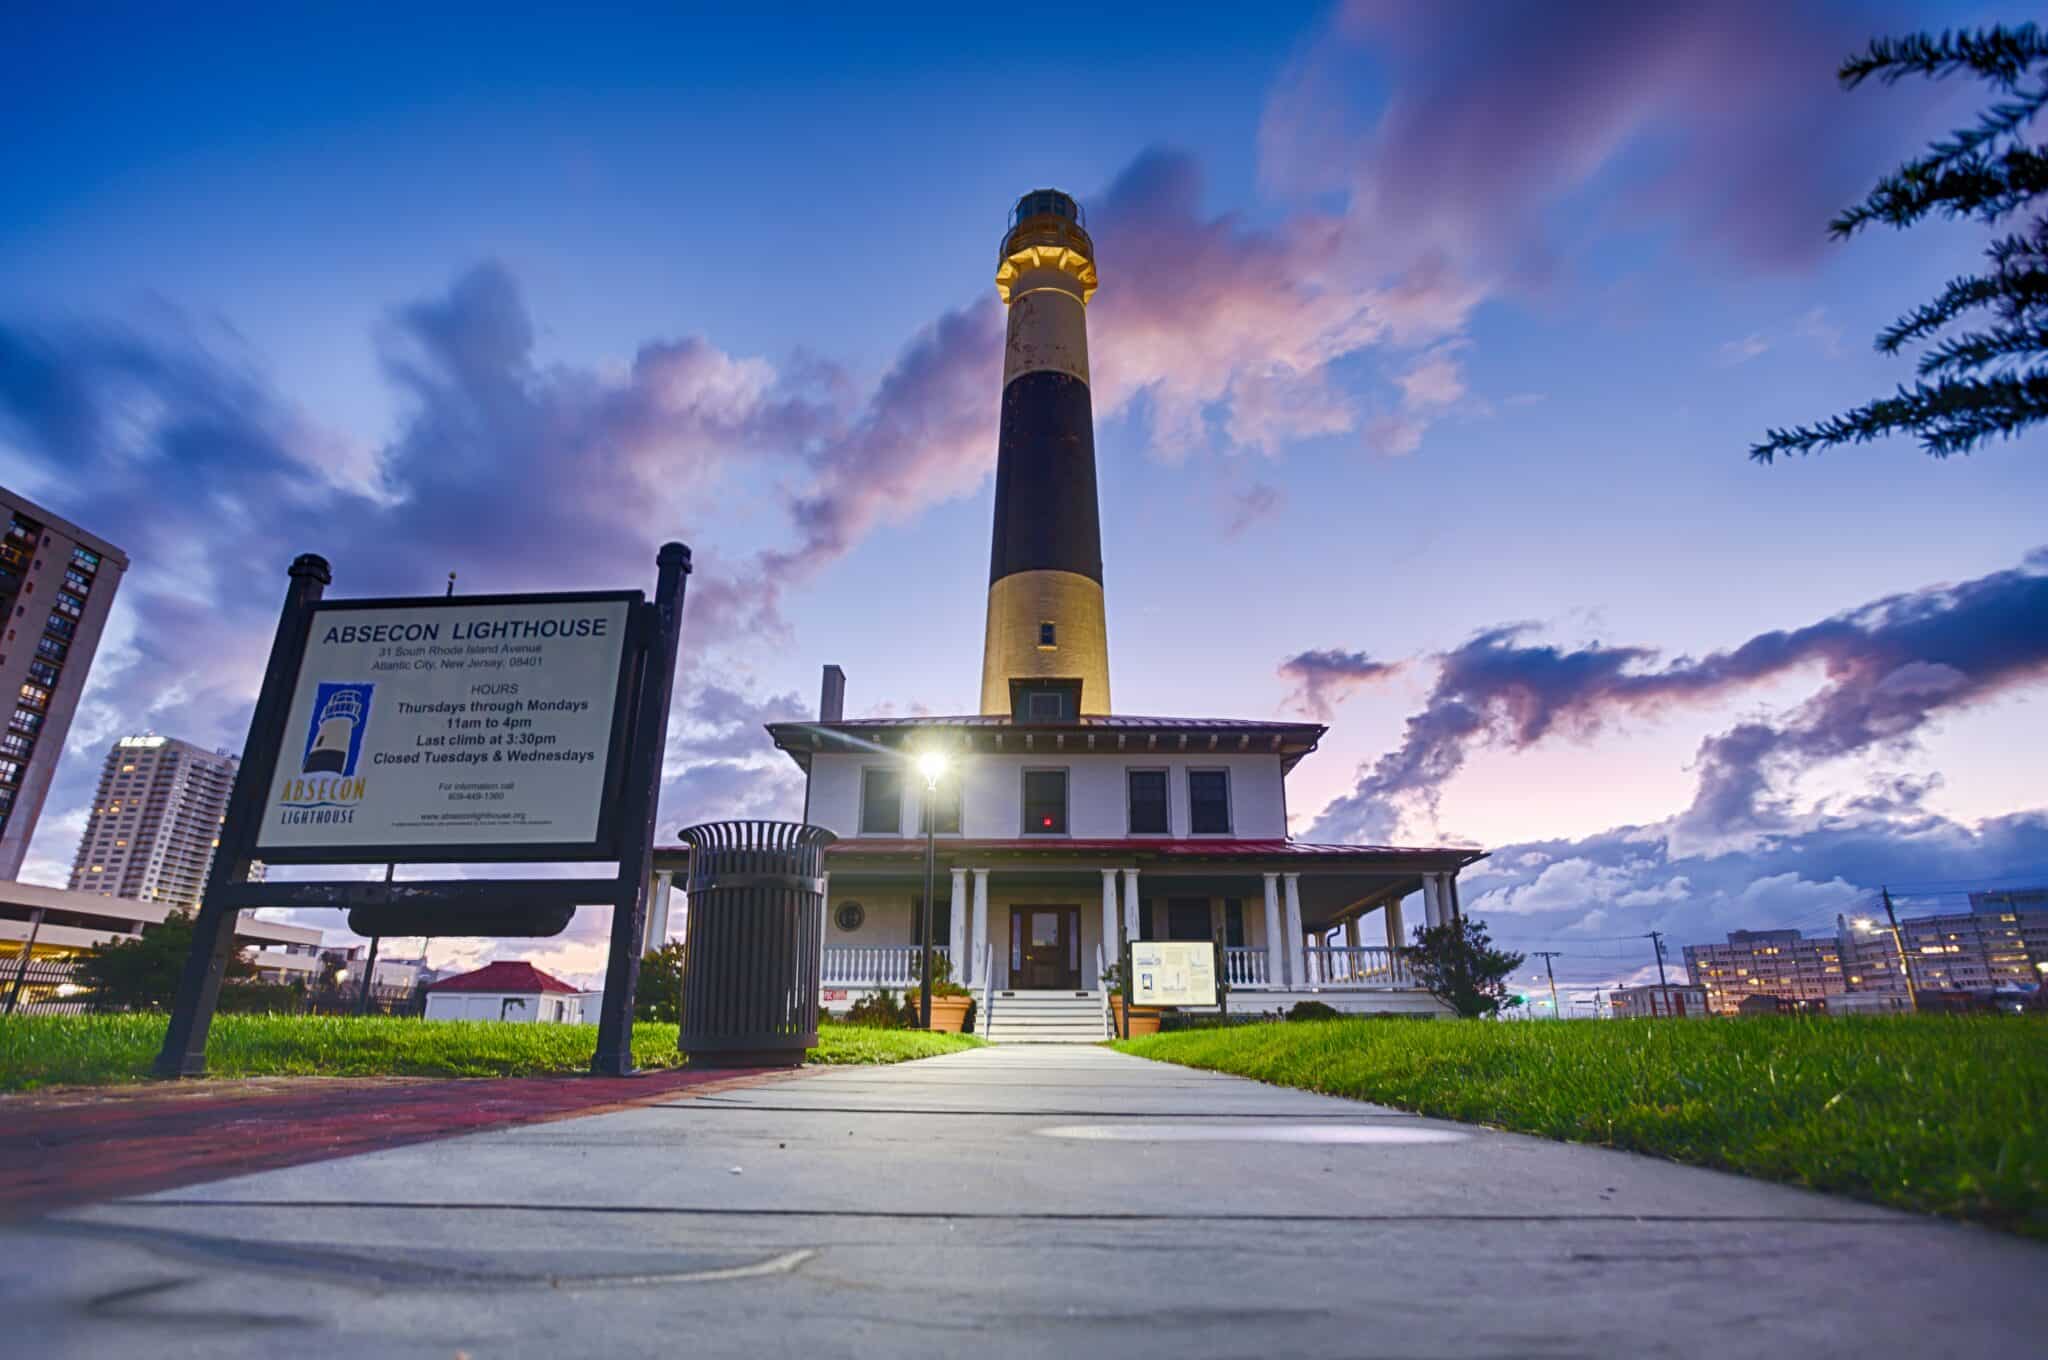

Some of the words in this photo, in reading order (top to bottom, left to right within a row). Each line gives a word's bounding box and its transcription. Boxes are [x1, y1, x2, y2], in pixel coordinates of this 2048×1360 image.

[322, 624, 439, 644] ABSECON
[452, 619, 608, 640] LIGHTHOUSE
[379, 647, 392, 657] 31
[395, 646, 427, 657] South
[429, 645, 463, 656] Rhode
[466, 644, 500, 655] Island
[501, 644, 543, 654] Avenue
[371, 659, 411, 671] Atlantic
[440, 658, 465, 669] New
[509, 656, 543, 668] 08401
[471, 684, 519, 695] HOURS
[398, 702, 466, 715] Thursdays
[470, 700, 523, 714] through
[527, 699, 588, 713] Mondays
[447, 718, 481, 729] 11am
[485, 717, 498, 728] to
[502, 717, 532, 730] 4pm
[416, 735, 445, 746] Last
[449, 733, 486, 746] climb
[489, 734, 502, 745] at
[505, 733, 556, 746] 3:30pm
[373, 752, 420, 765] Closed
[424, 751, 488, 765] Tuesdays
[492, 751, 502, 762] &
[507, 749, 595, 763] Wednesdays
[281, 777, 366, 801] ABSECON
[281, 809, 356, 825] LIGHTHOUSE
